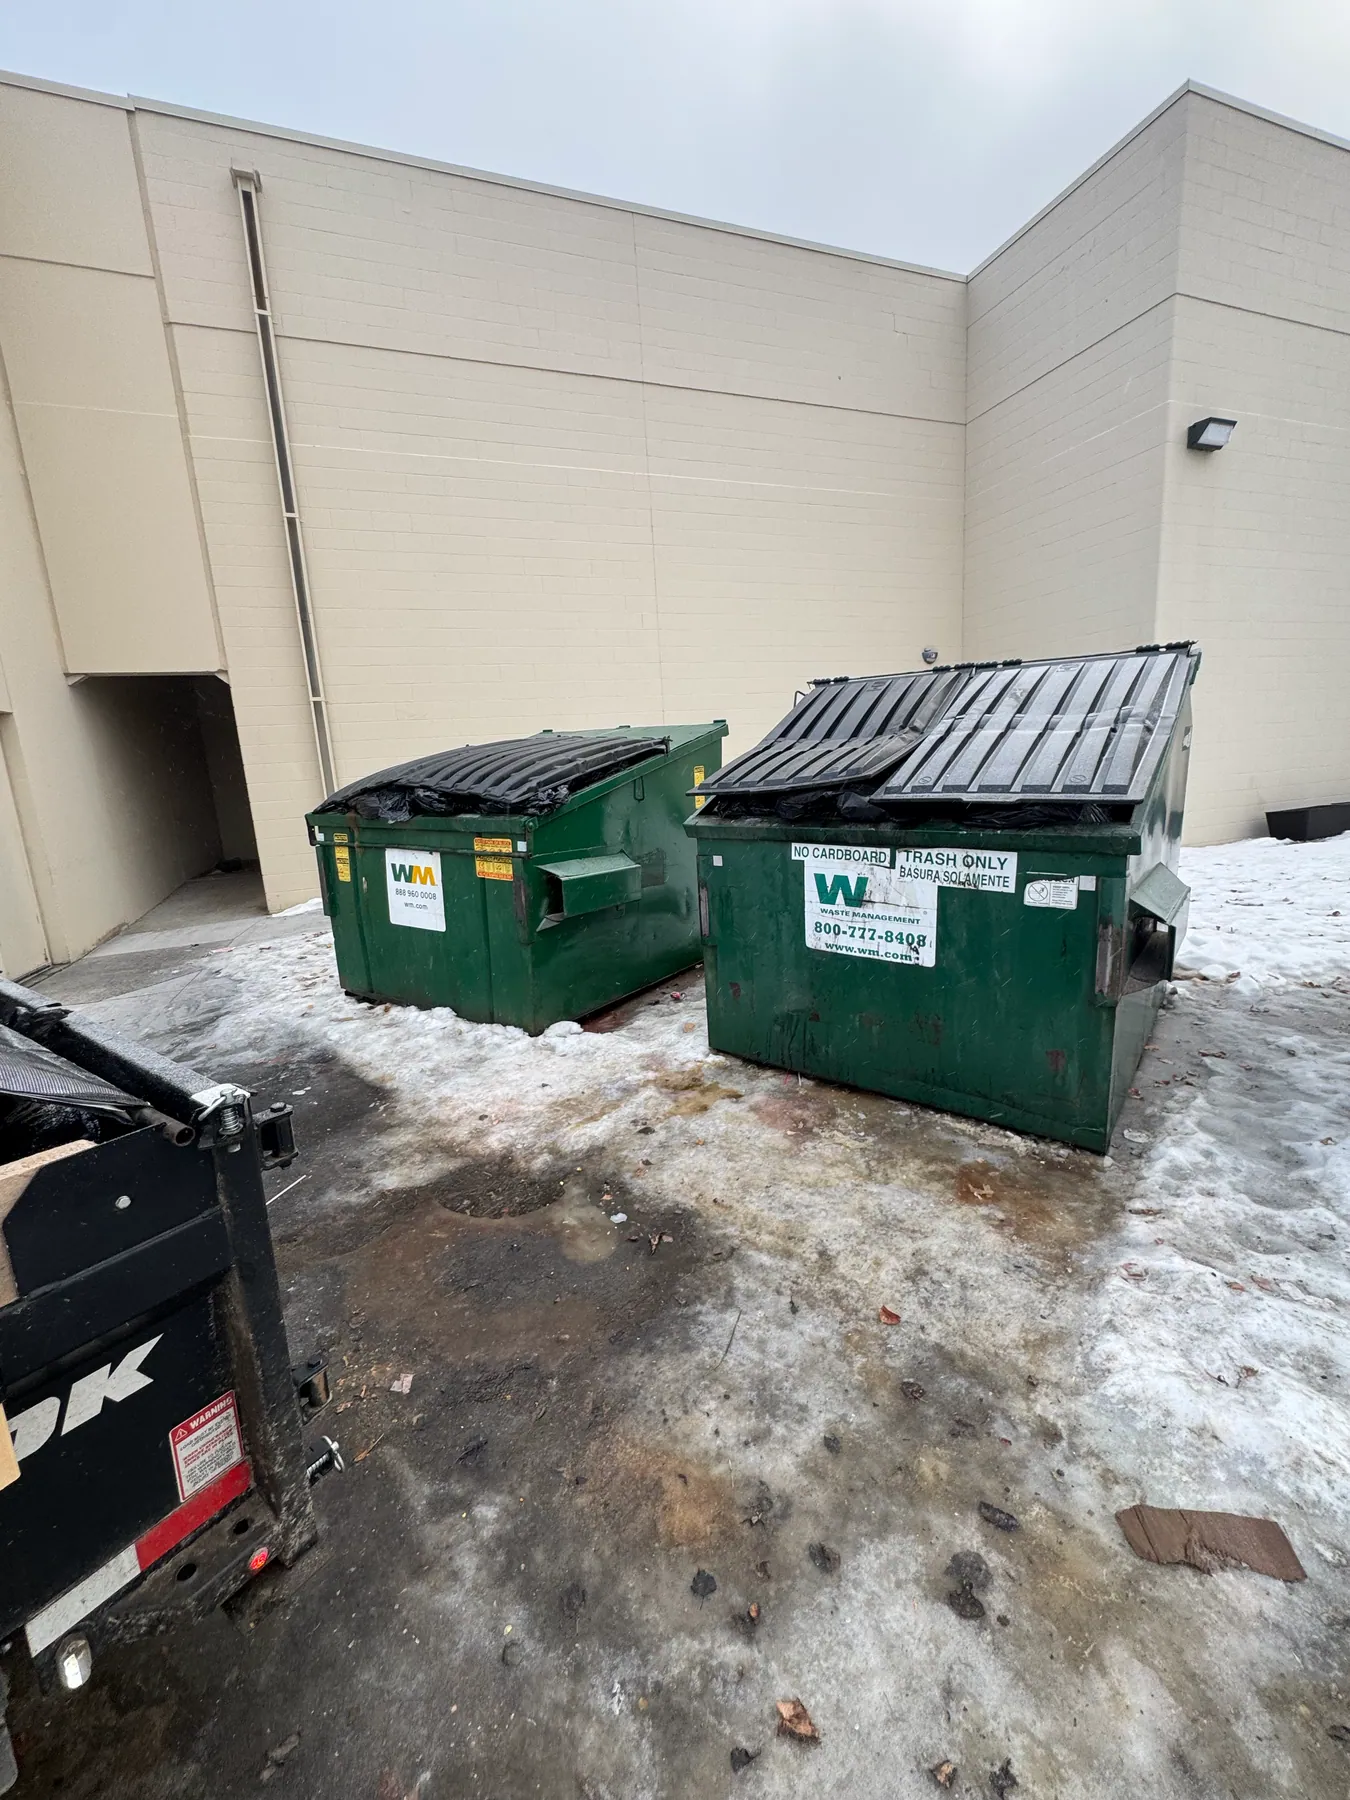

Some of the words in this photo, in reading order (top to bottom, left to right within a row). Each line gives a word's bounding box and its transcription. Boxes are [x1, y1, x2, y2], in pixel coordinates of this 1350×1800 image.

[794, 846, 809, 858] NO
[812, 847, 887, 863] CARDBOARD
[904, 850, 957, 866] TRASH
[962, 854, 1008, 871] ONLY
[391, 863, 436, 886] WM
[900, 866, 940, 882] BASURA
[943, 870, 1010, 888] SOLAMENTE
[395, 888, 406, 896] 888
[407, 889, 419, 898] 960
[420, 891, 437, 900] 0008
[404, 902, 428, 910] wm.com
[820, 908, 850, 917] WASTE
[852, 911, 920, 925] MANAGEMENT
[814, 921, 927, 947] 800-777-8408
[825, 942, 912, 962] www.wm.com
[189, 1397, 233, 1430] WARNING
